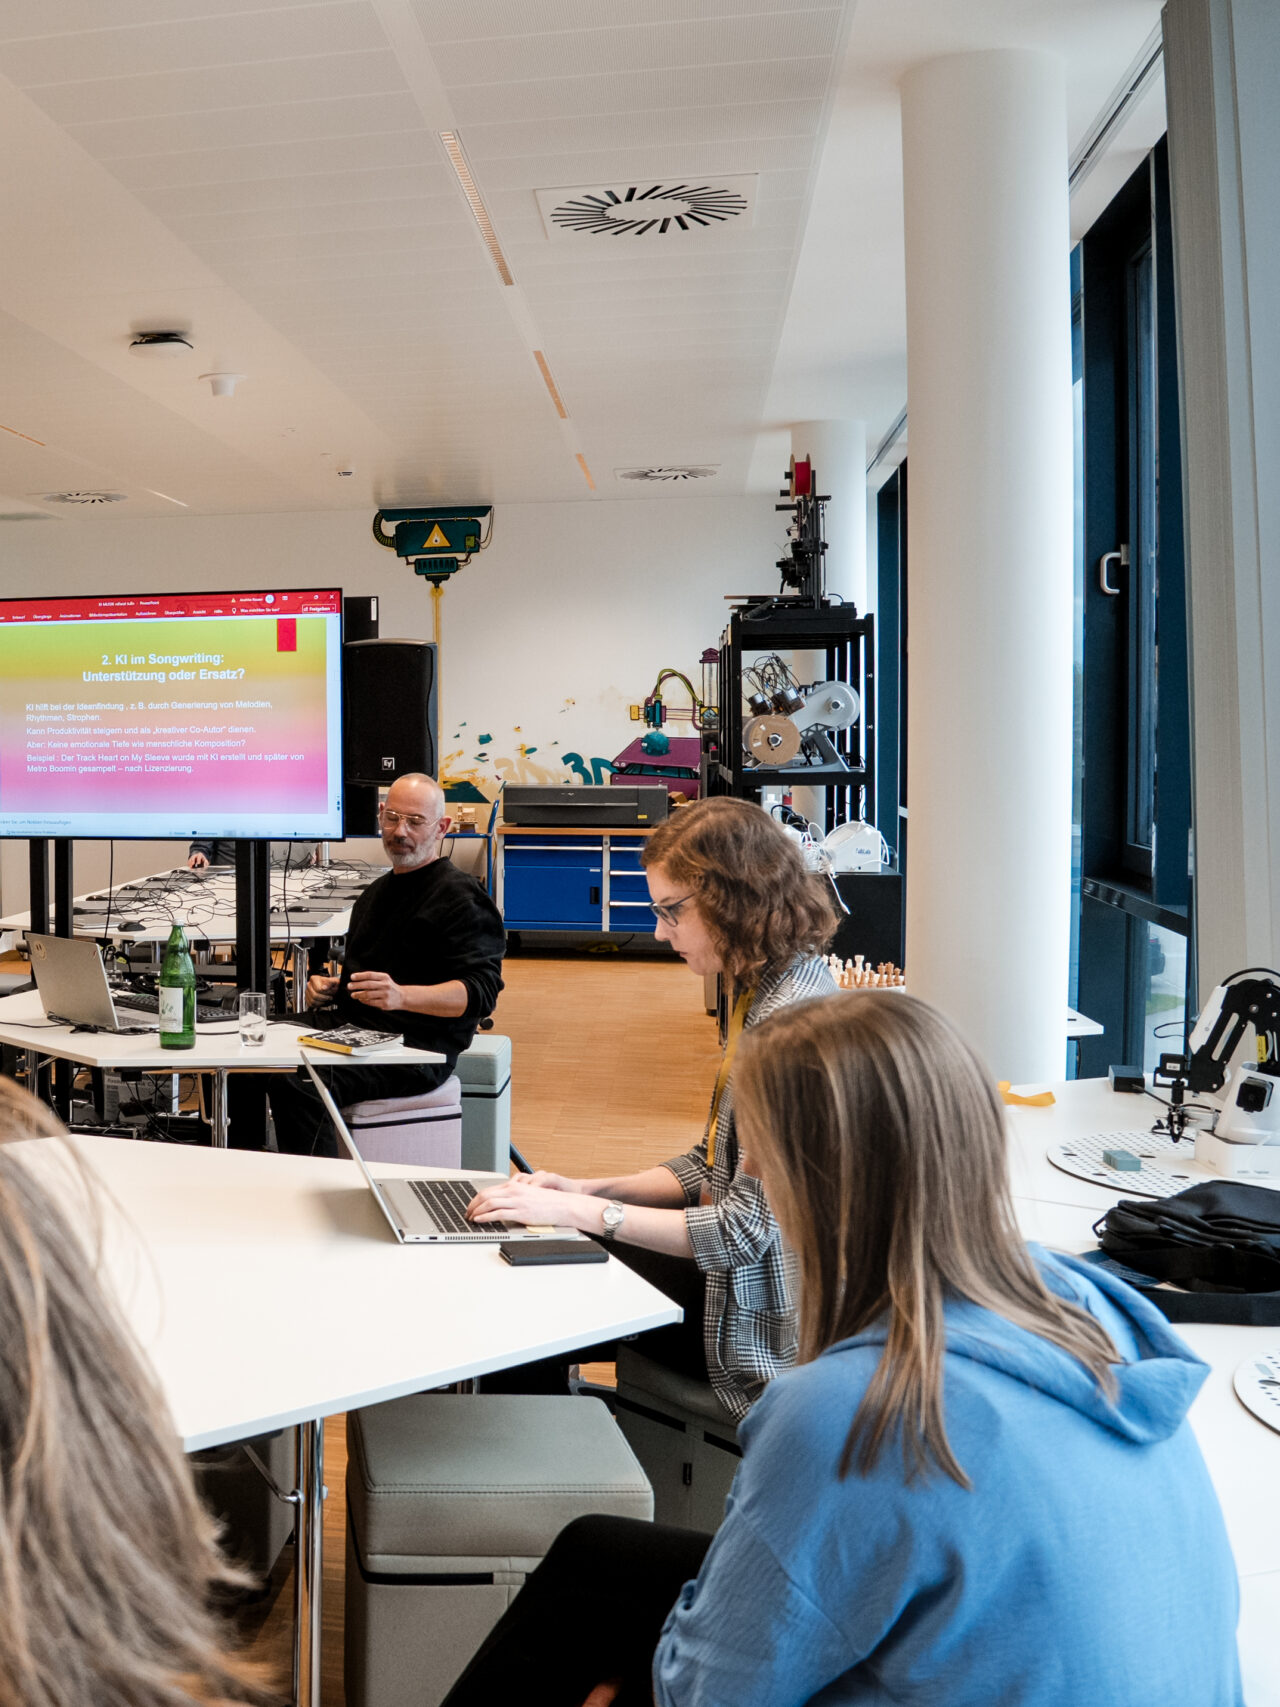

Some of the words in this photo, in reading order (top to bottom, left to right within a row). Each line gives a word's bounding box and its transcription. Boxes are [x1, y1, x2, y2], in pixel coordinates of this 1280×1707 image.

[102, 655, 112, 665] 2.
[115, 654, 128, 664] KI
[131, 654, 146, 664] im
[148, 652, 224, 667] Songwriting:
[82, 670, 166, 684] Unterstützung
[168, 670, 197, 682] oder
[200, 668, 244, 680] Ersatz?
[148, 702, 169, 710] durch
[171, 702, 218, 710] Generierung
[236, 701, 272, 709] Melodien,
[48, 728, 92, 736] Produktivität
[93, 728, 122, 736] steigern
[194, 740, 246, 748] Komposition?
[132, 754, 142, 762] My
[145, 753, 170, 761] Sleeve
[264, 752, 288, 762] später
[78, 765, 116, 774] gesampelt
